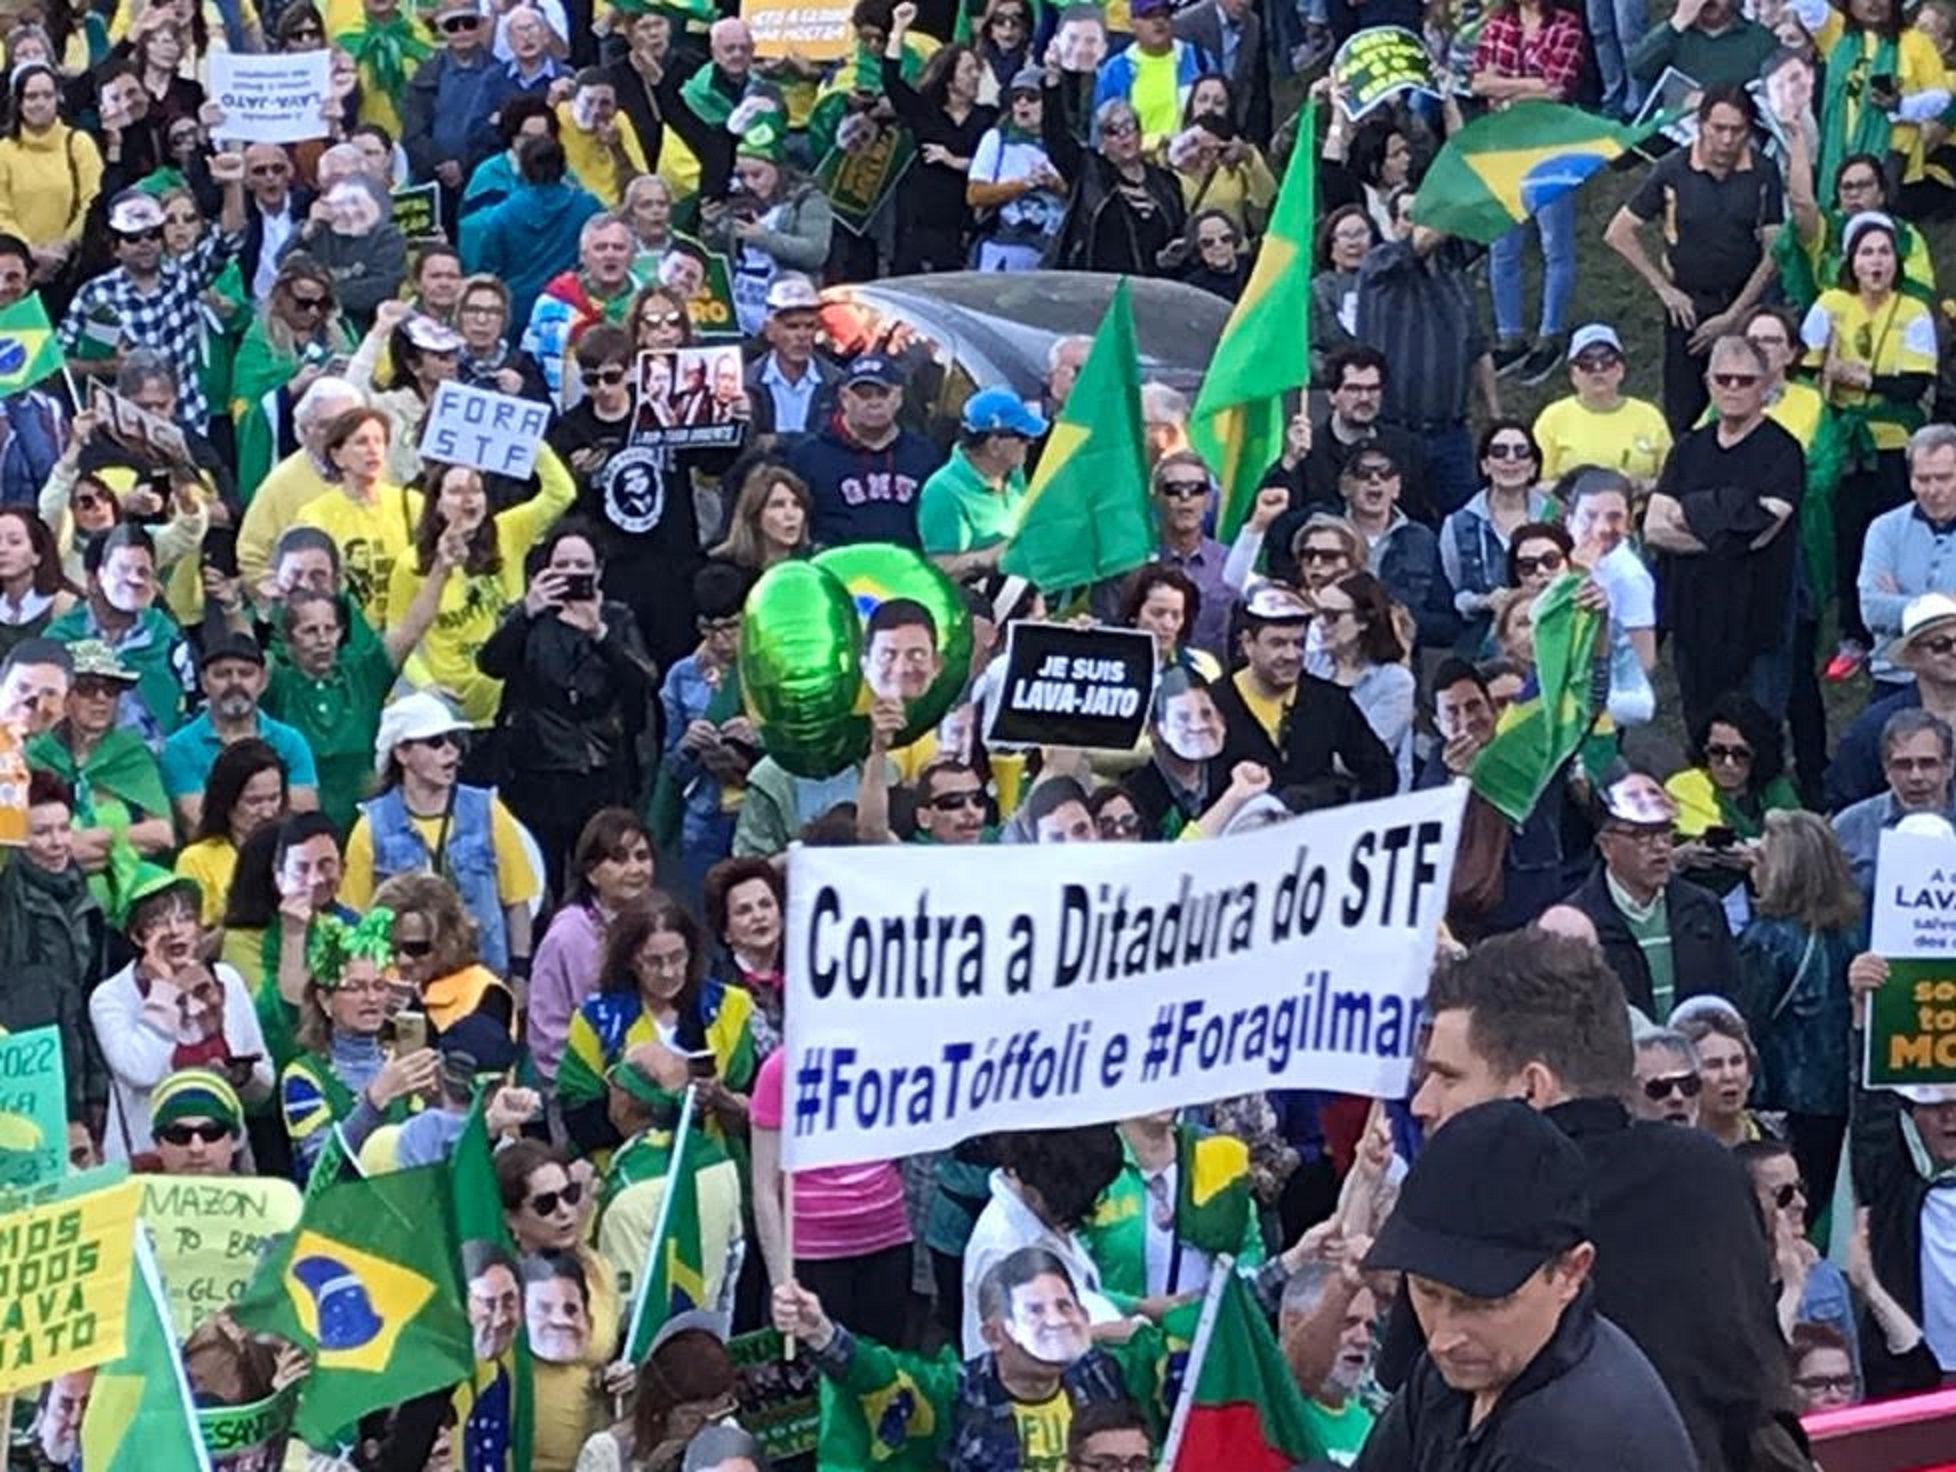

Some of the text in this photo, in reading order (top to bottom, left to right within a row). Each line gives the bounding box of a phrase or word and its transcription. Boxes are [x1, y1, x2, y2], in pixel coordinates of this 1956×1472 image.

[438, 392, 545, 438] FORA
[434, 429, 529, 470] STF
[1038, 655, 1125, 682] JE SUIS
[1011, 679, 1140, 718] LAVA-JATO
[808, 821, 1442, 999] Contra a Ditadura do STF
[1895, 885, 1956, 910] LAV
[0, 1037, 56, 1078] 022
[1101, 1033, 1128, 1088] e
